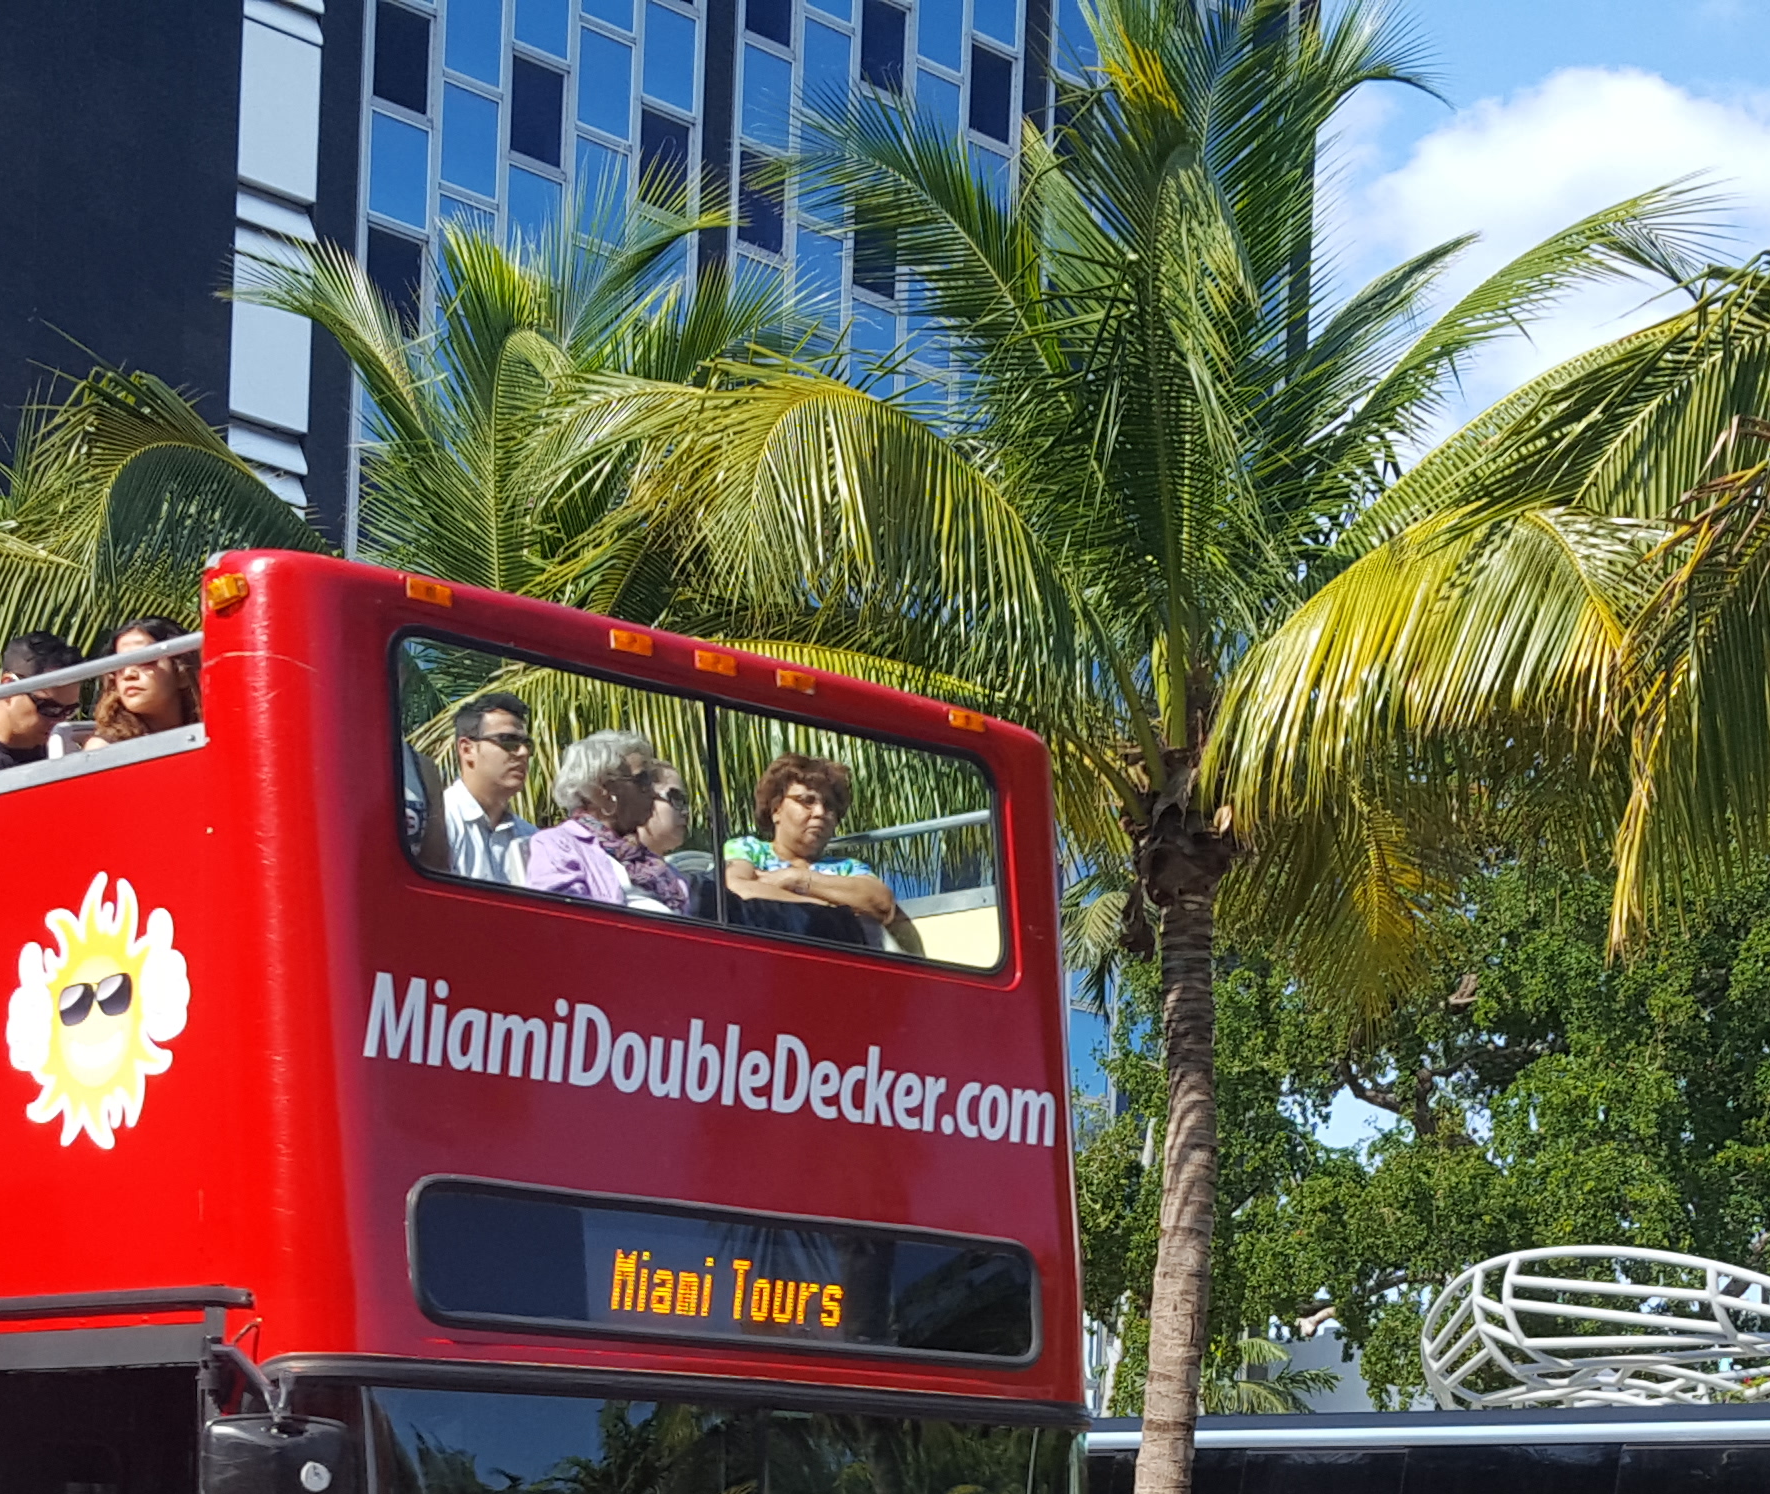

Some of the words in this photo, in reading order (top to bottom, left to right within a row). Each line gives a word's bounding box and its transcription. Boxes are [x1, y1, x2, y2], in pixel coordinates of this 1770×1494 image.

[363, 972, 1055, 1147] MiamiDoubleDecker.com
[611, 1248, 714, 1318] Miami
[733, 1259, 844, 1328] Tours
